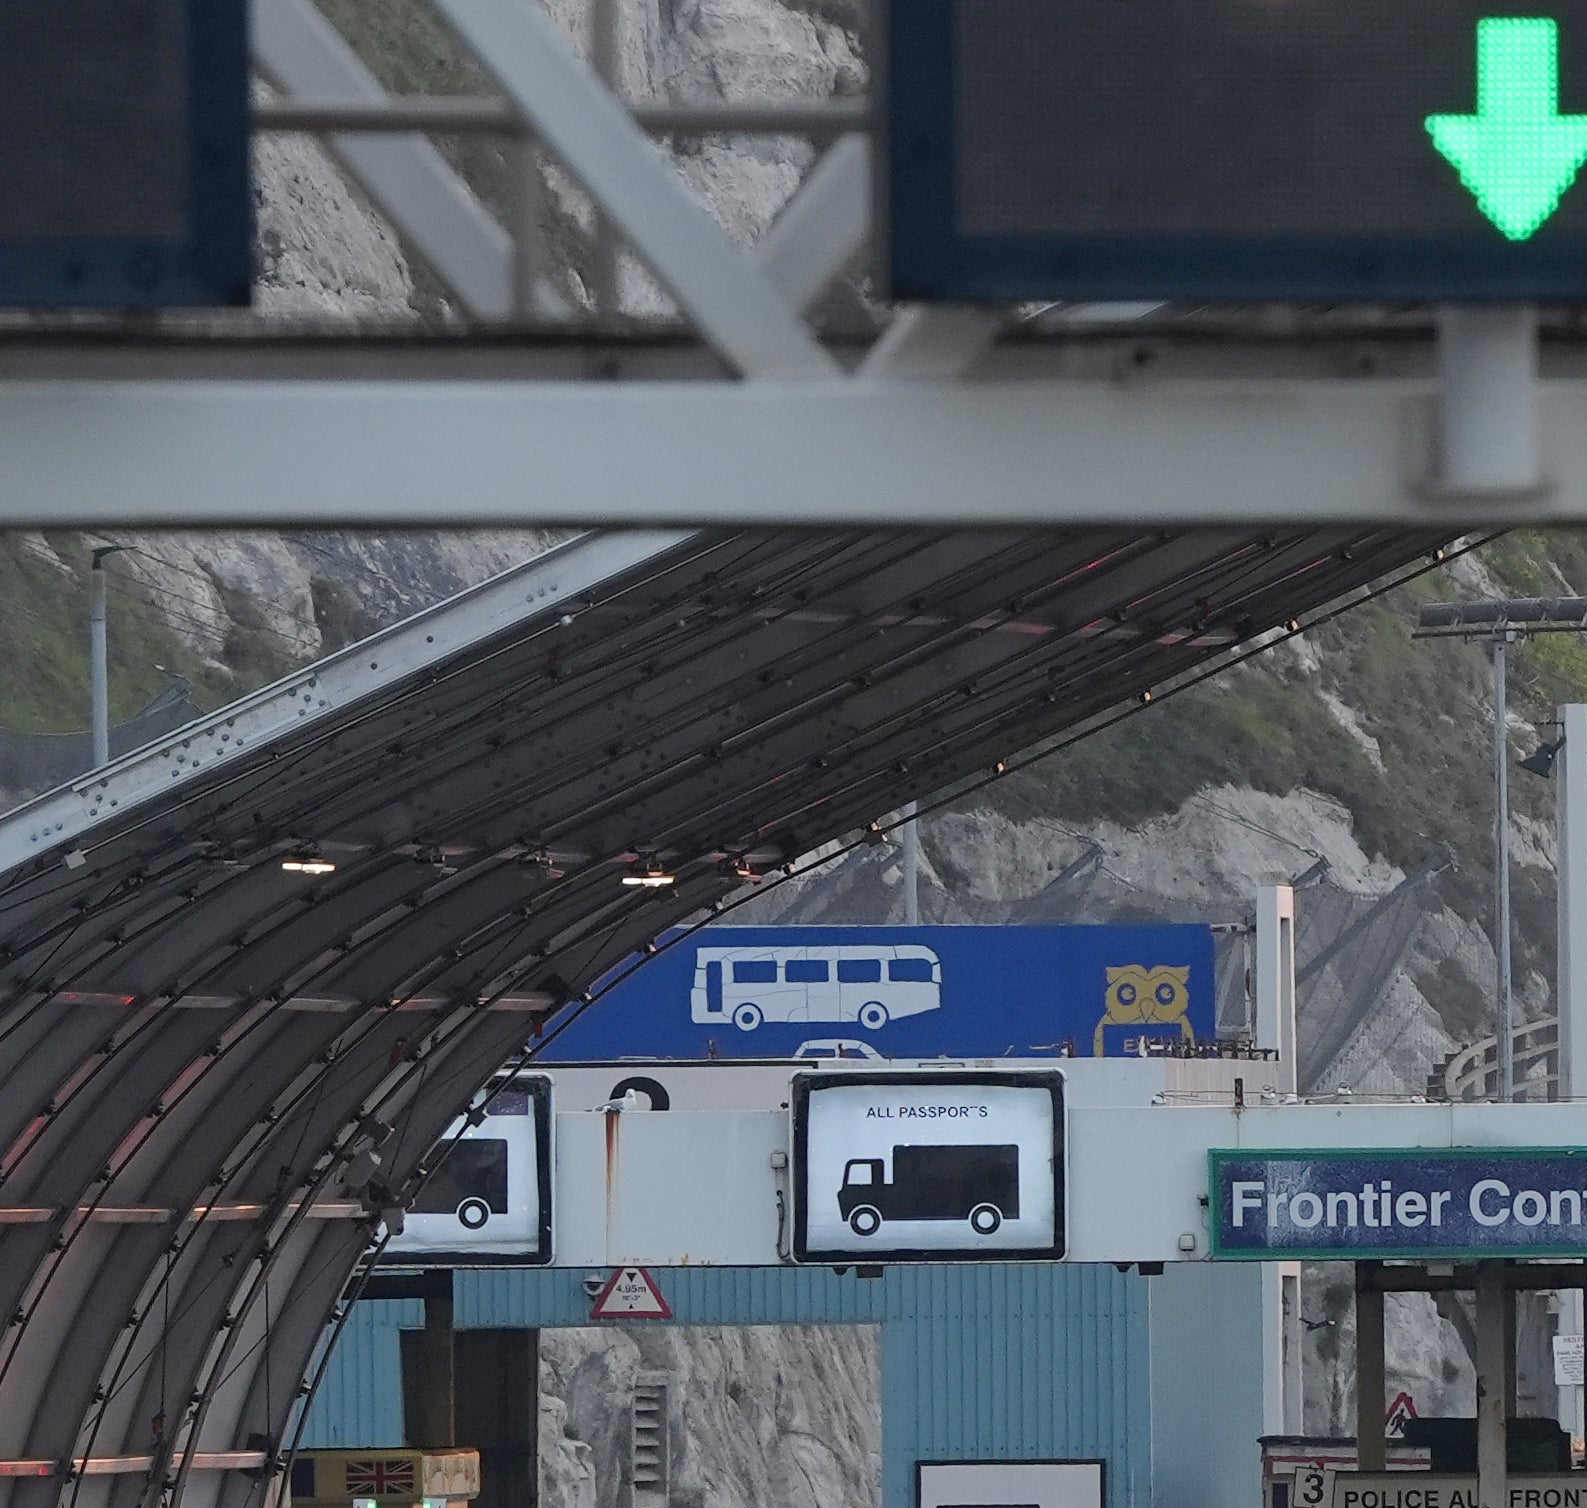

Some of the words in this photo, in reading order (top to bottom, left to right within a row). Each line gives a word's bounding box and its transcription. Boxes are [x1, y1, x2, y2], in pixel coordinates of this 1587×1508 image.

[866, 1106, 895, 1119] ALL
[898, 1105, 989, 1119] PASSPORS
[1231, 1180, 1451, 1228] Frontier
[616, 1284, 647, 1294] 4.95m
[1302, 1473, 1325, 1504] 3
